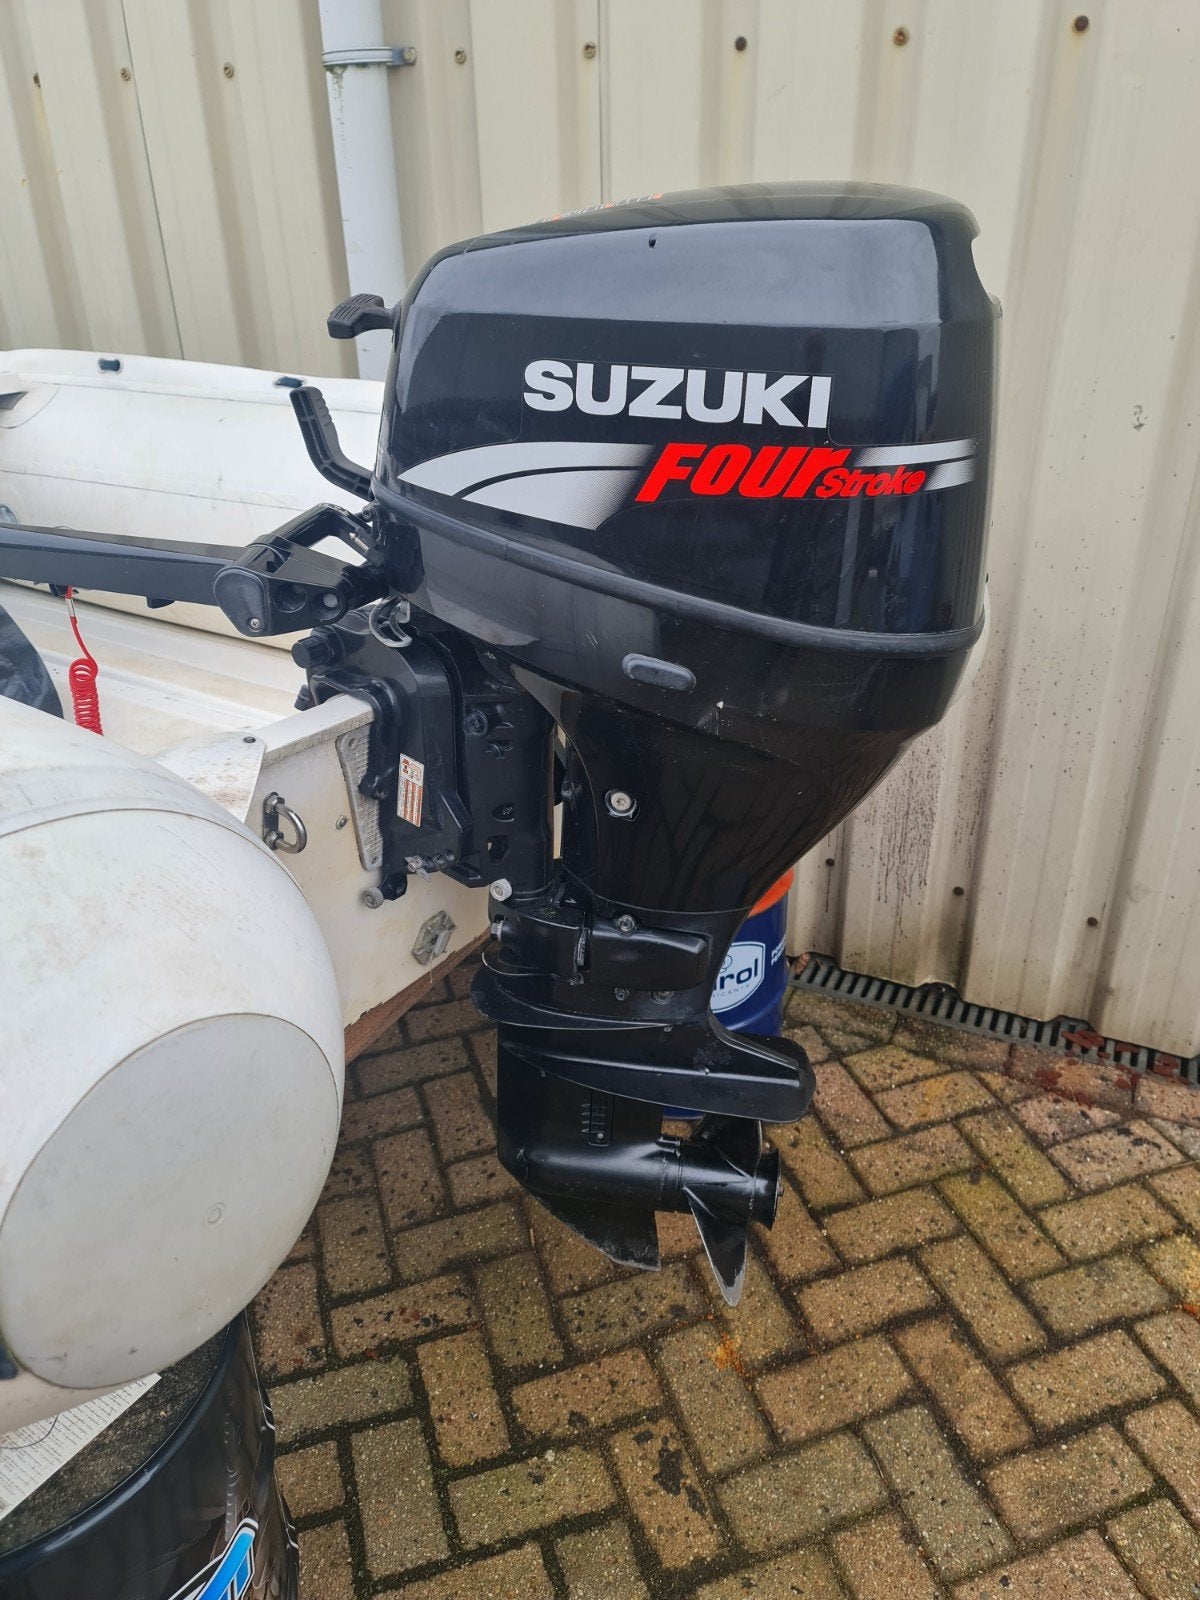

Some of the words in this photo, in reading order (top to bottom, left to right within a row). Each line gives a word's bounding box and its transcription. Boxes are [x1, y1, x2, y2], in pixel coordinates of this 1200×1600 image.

[523, 359, 832, 429] SUZUKI
[815, 465, 927, 499] Stroke
[713, 957, 758, 991] rol
